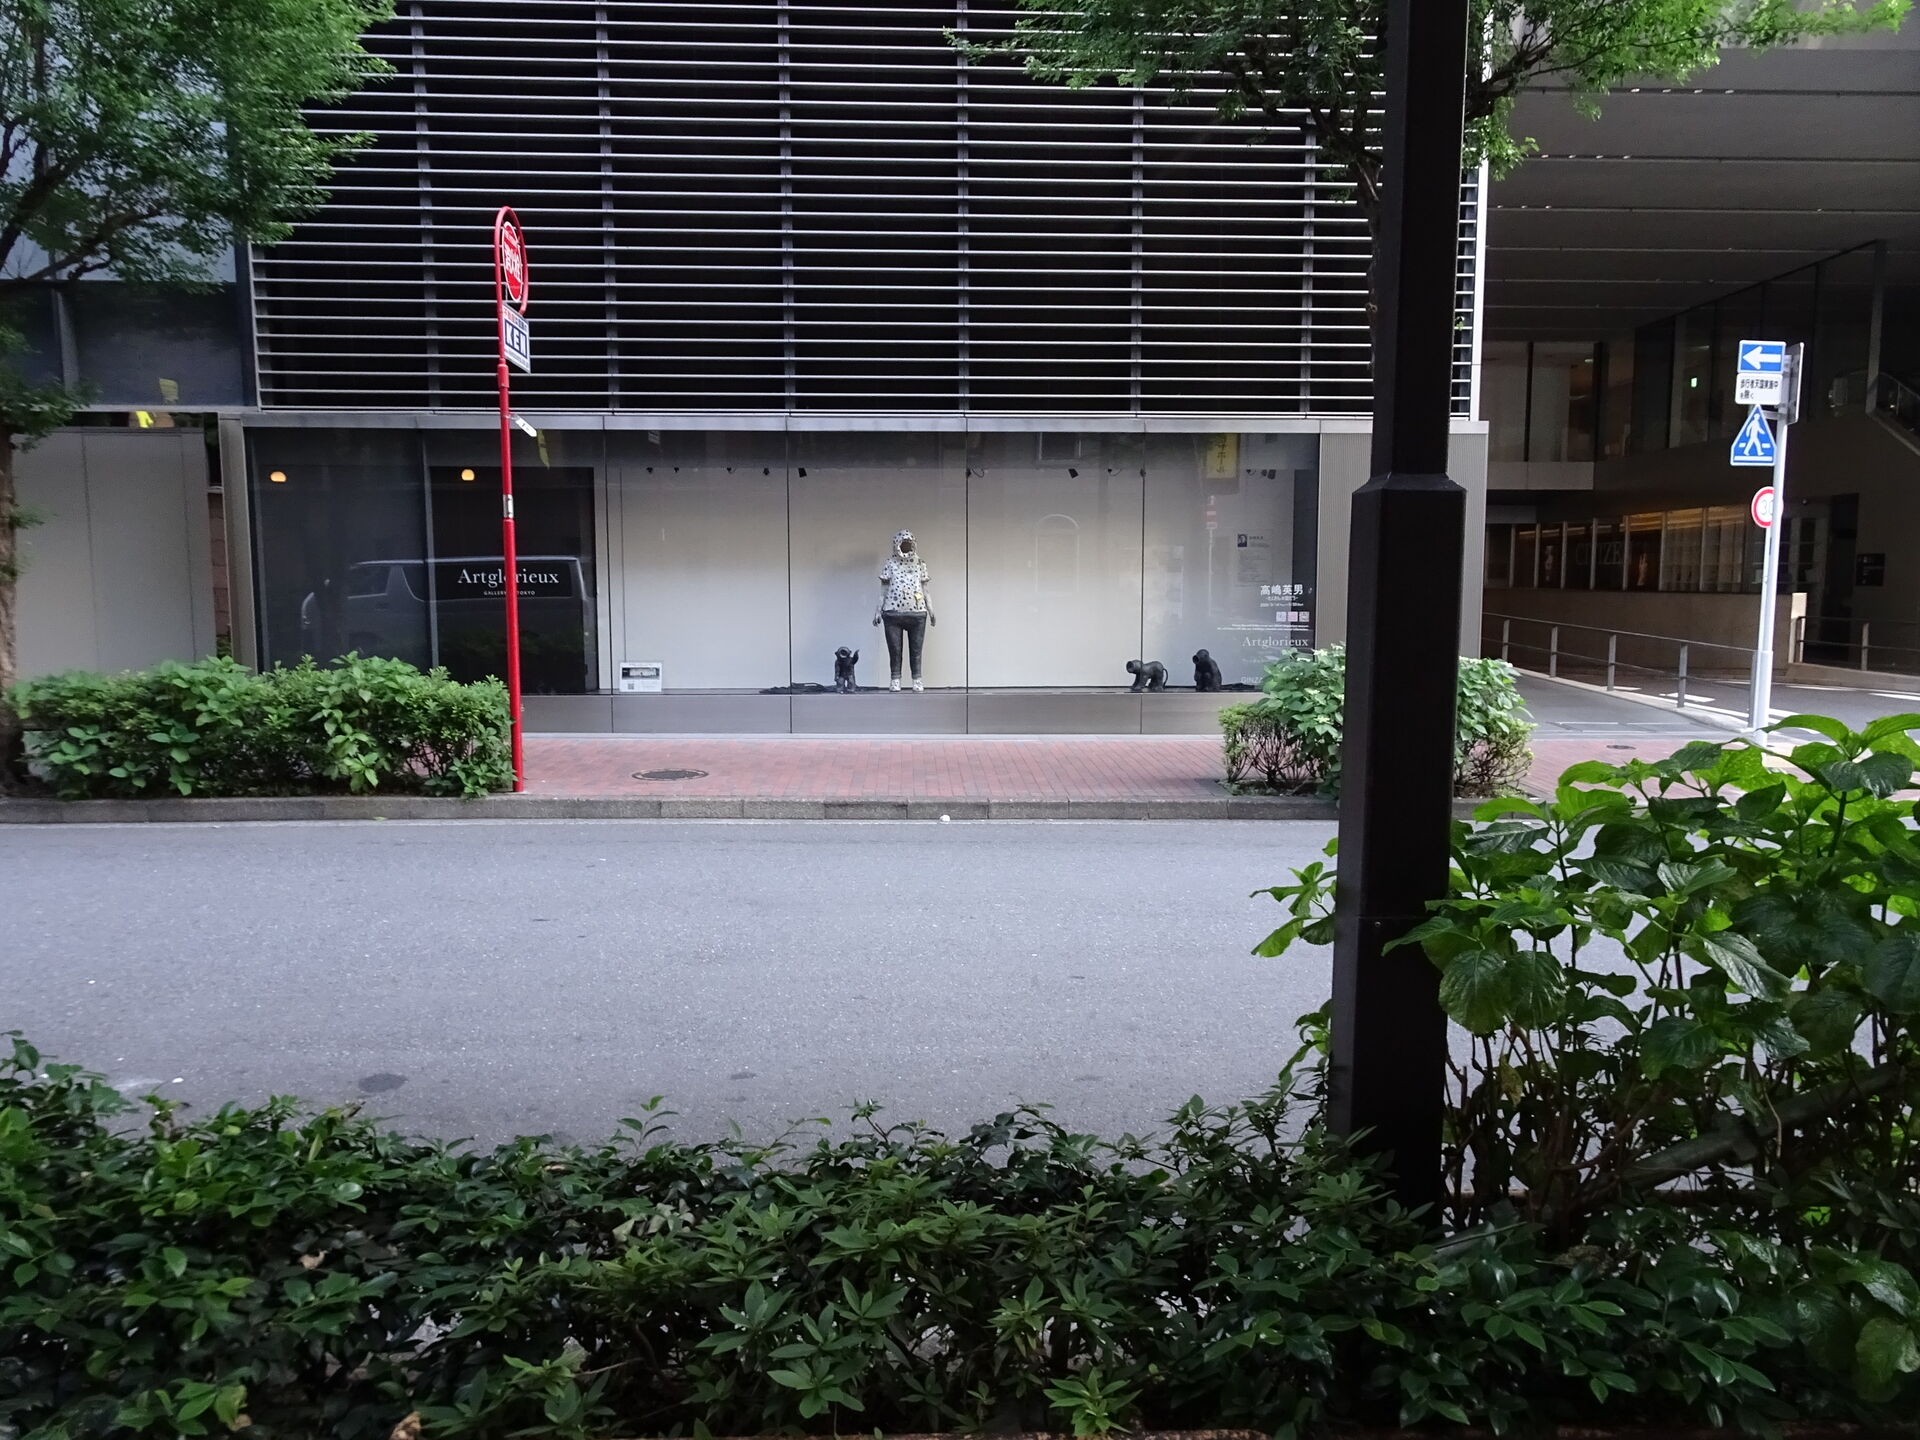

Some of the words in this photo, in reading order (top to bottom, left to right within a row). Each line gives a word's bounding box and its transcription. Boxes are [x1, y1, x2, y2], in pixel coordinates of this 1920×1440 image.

[506, 322, 526, 357] KEN
[457, 568, 559, 588] Artglrieux
[1242, 635, 1309, 650] Artglorieux
